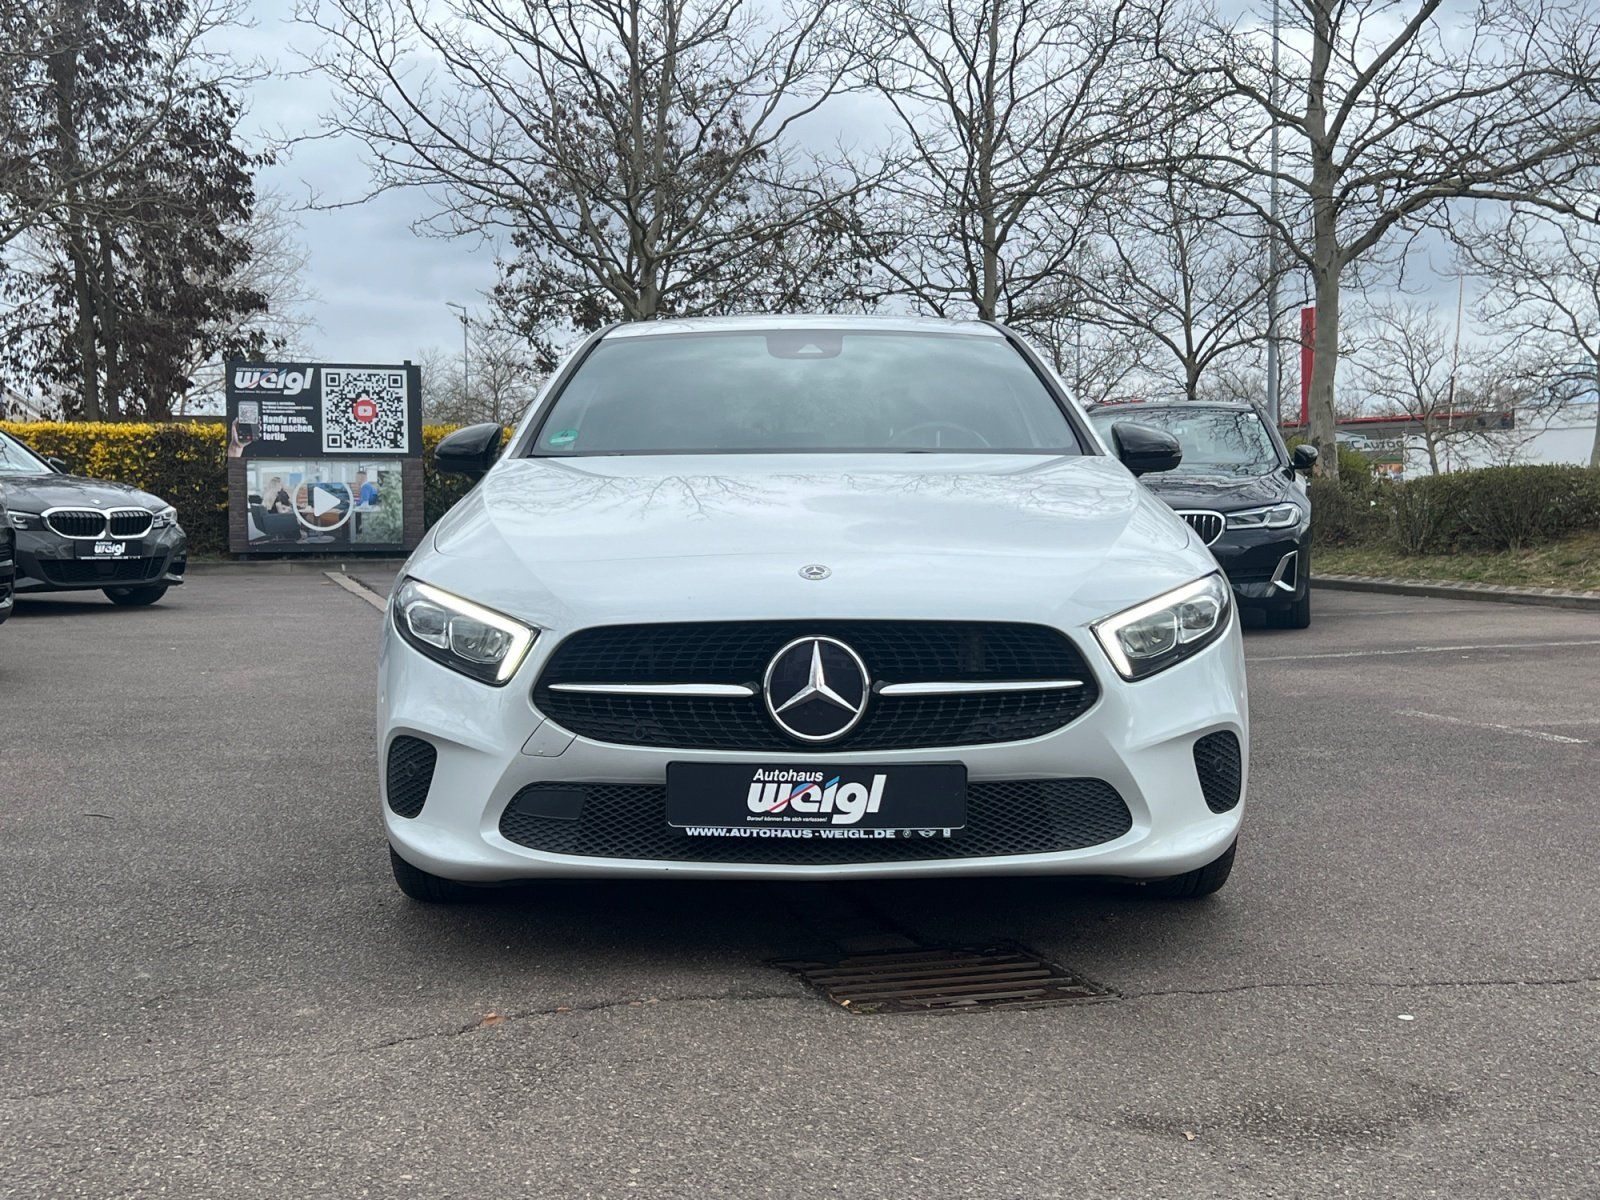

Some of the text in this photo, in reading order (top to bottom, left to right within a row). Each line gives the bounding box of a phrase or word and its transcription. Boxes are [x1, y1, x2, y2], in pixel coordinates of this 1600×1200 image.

[234, 368, 314, 395] weigl
[262, 415, 308, 424] Handy raus,
[262, 424, 314, 433] Foto machen,
[263, 432, 287, 442] fertig.
[94, 542, 126, 556] weigl
[753, 768, 824, 782] Autohaus
[746, 774, 887, 825] weigl
